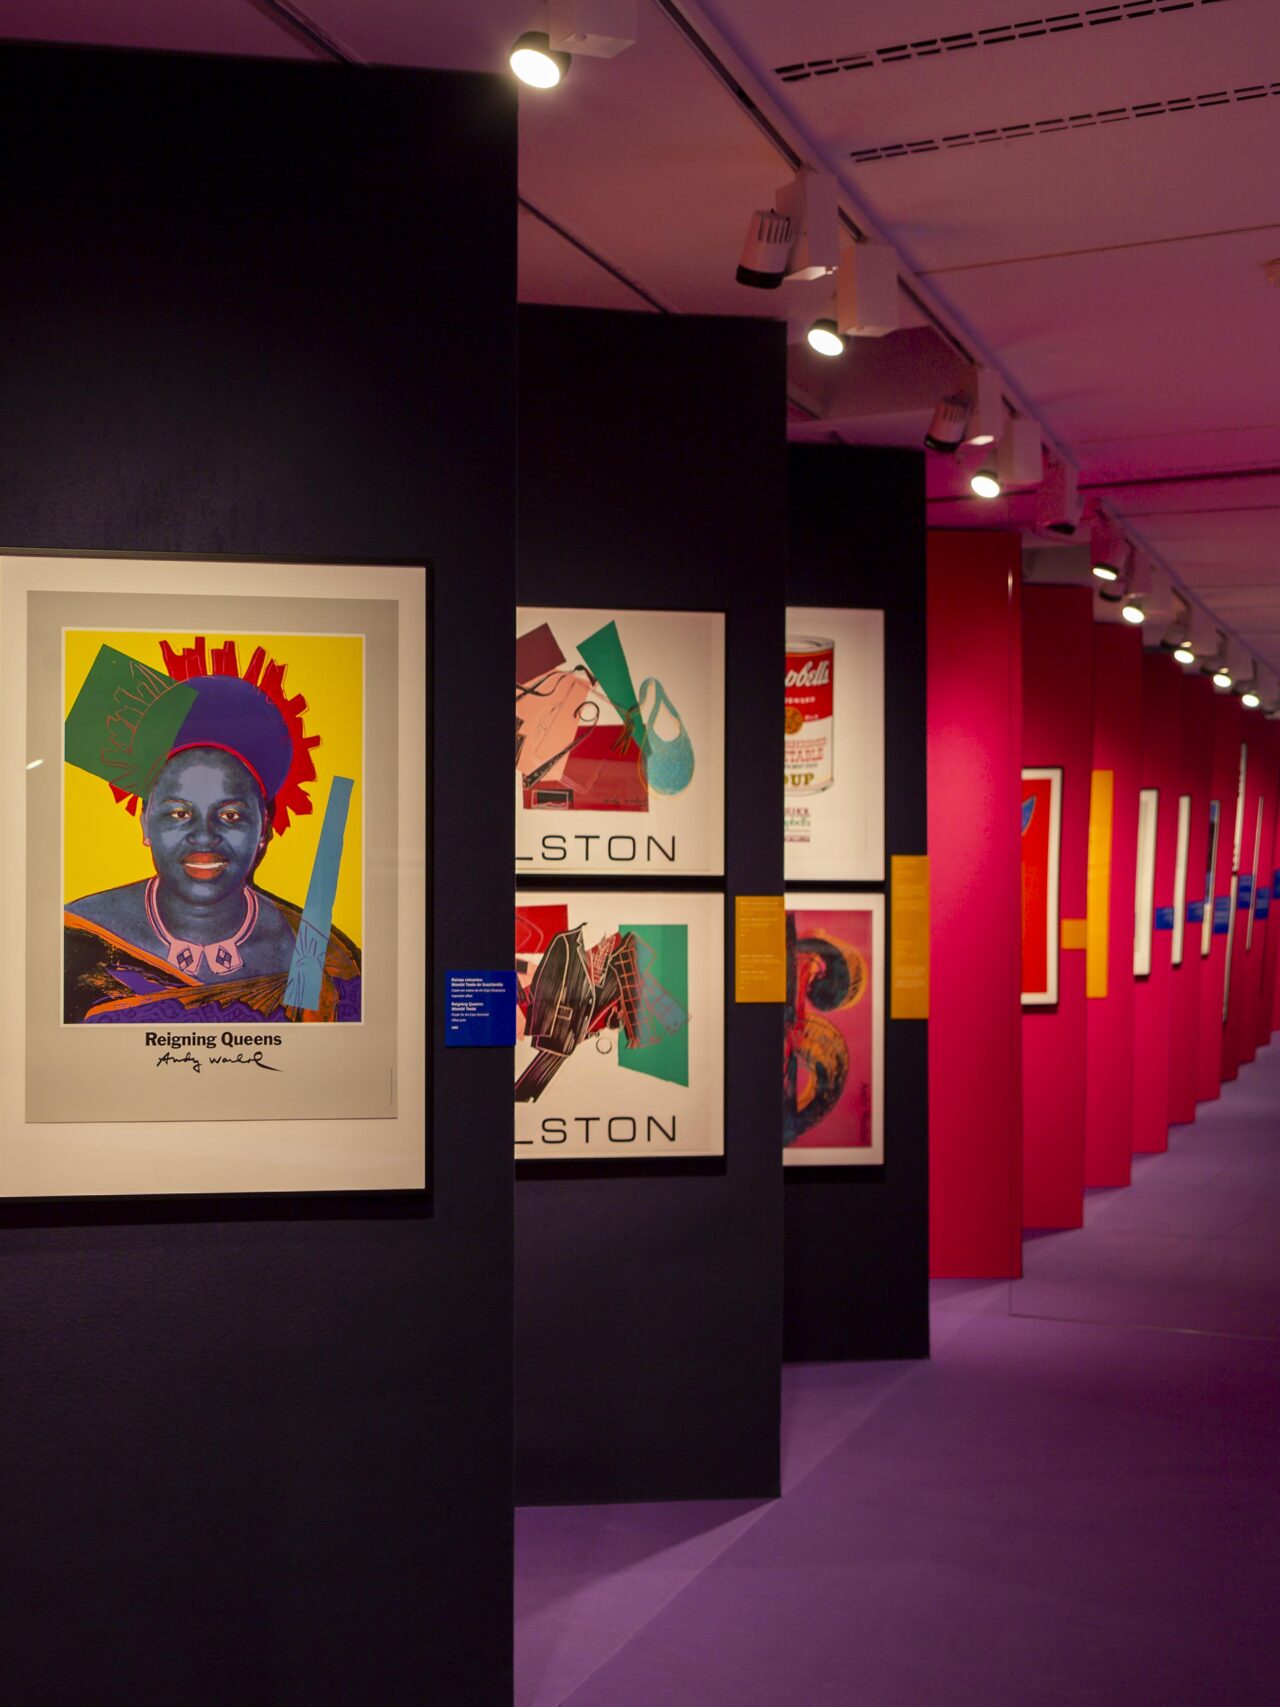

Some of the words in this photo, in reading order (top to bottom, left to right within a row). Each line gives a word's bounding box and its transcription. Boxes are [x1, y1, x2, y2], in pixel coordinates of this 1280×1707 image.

[146, 1031, 217, 1049] Reigning
[222, 1031, 282, 1048] Queens
[157, 1051, 202, 1073] Andy
